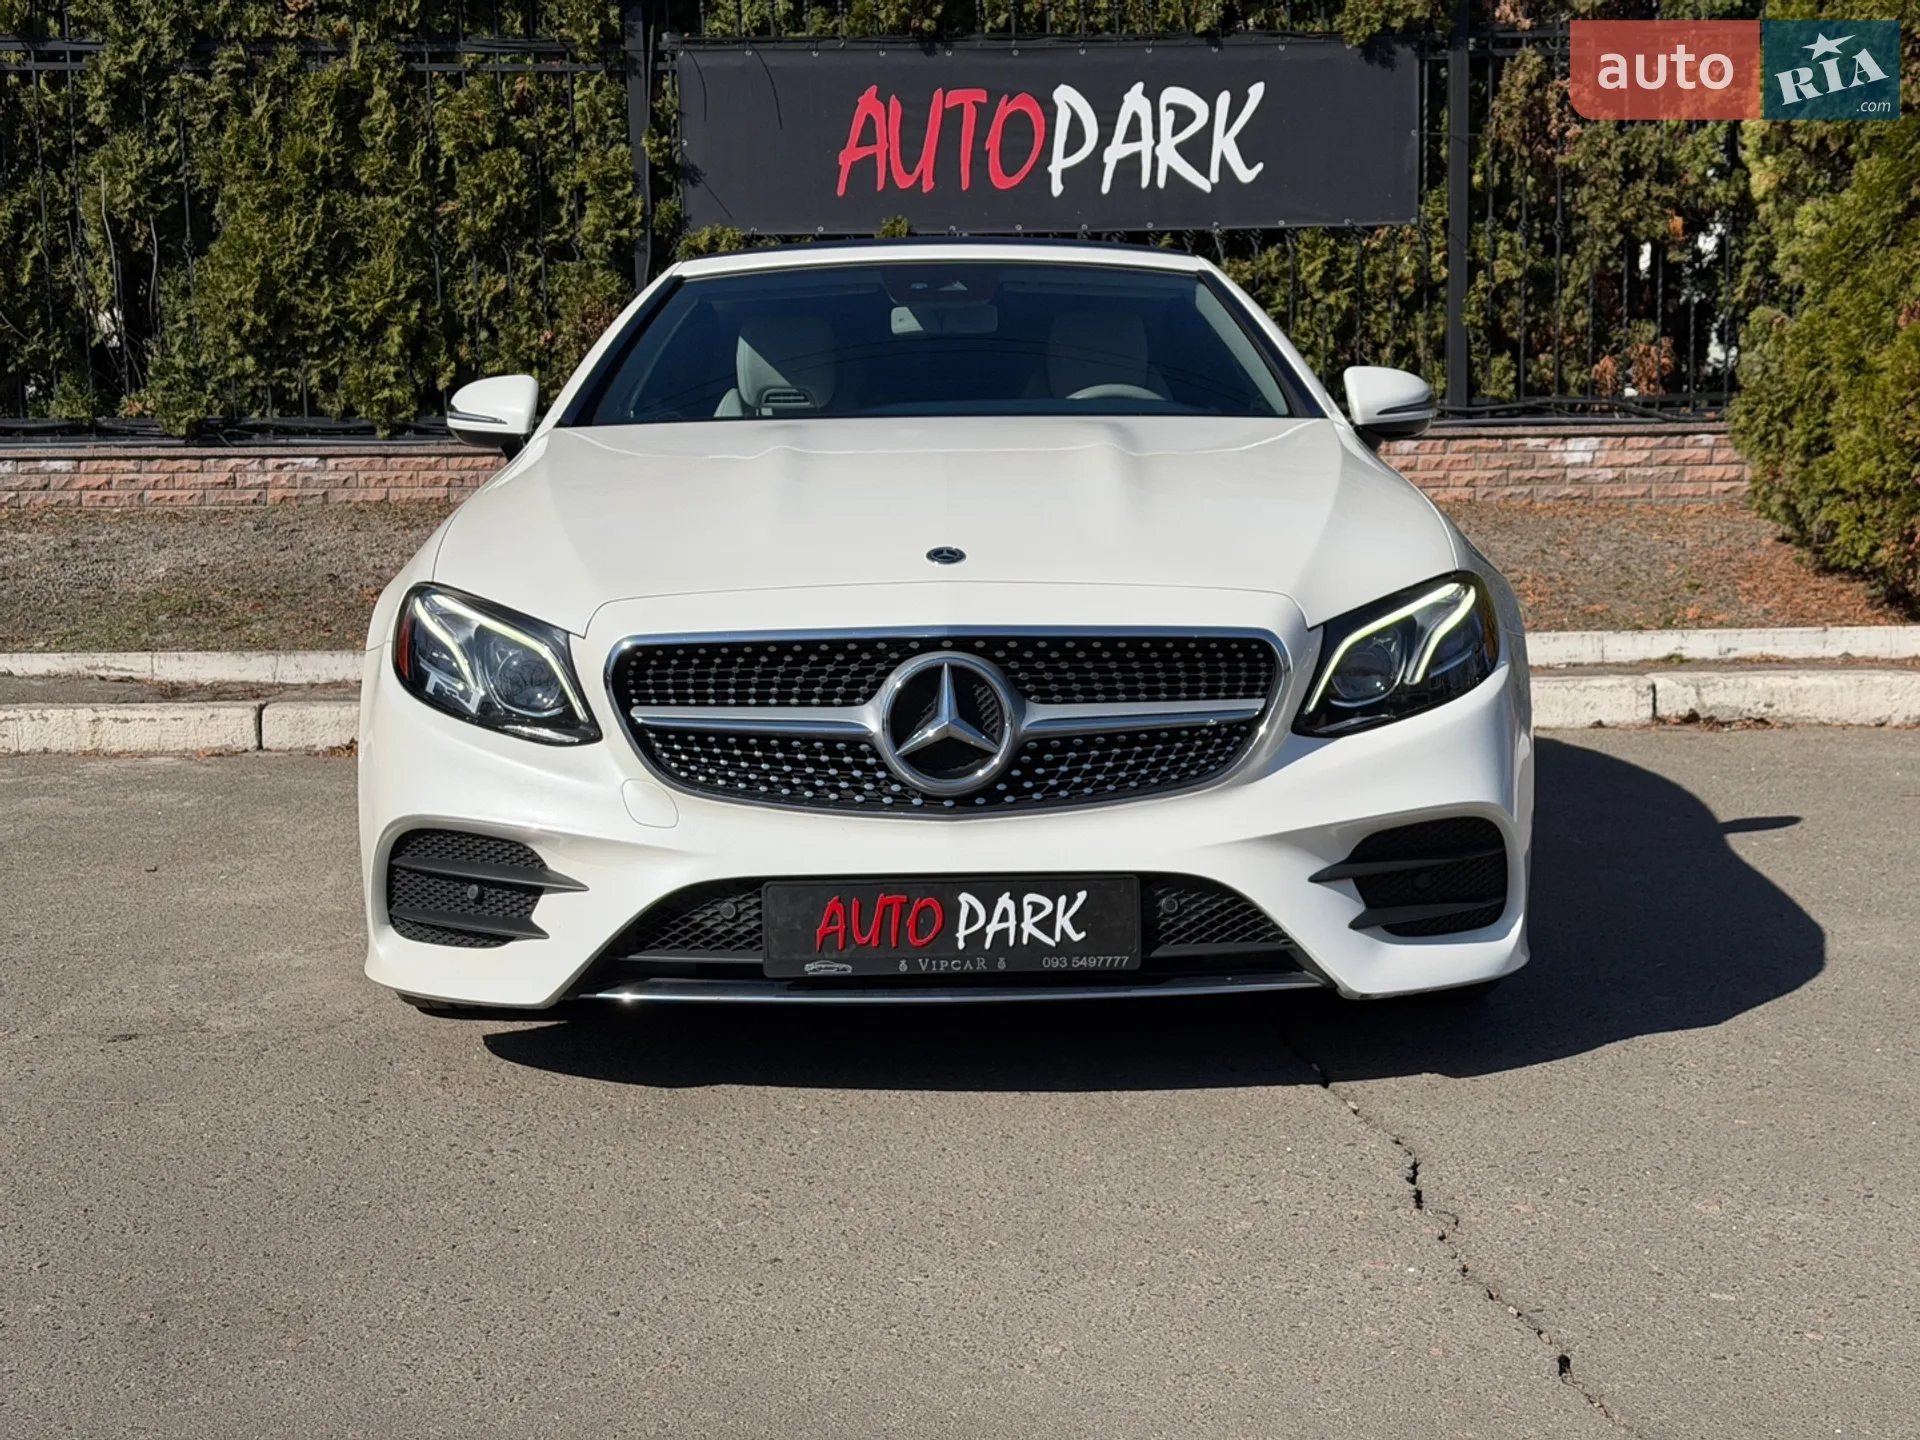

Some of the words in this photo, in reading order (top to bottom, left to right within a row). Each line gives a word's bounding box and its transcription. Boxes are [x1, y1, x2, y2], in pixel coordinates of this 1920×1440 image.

[815, 892, 944, 953] AUTO
[955, 889, 1088, 951] PARK
[1042, 956, 1068, 968] 093
[1071, 955, 1130, 968] 5497777
